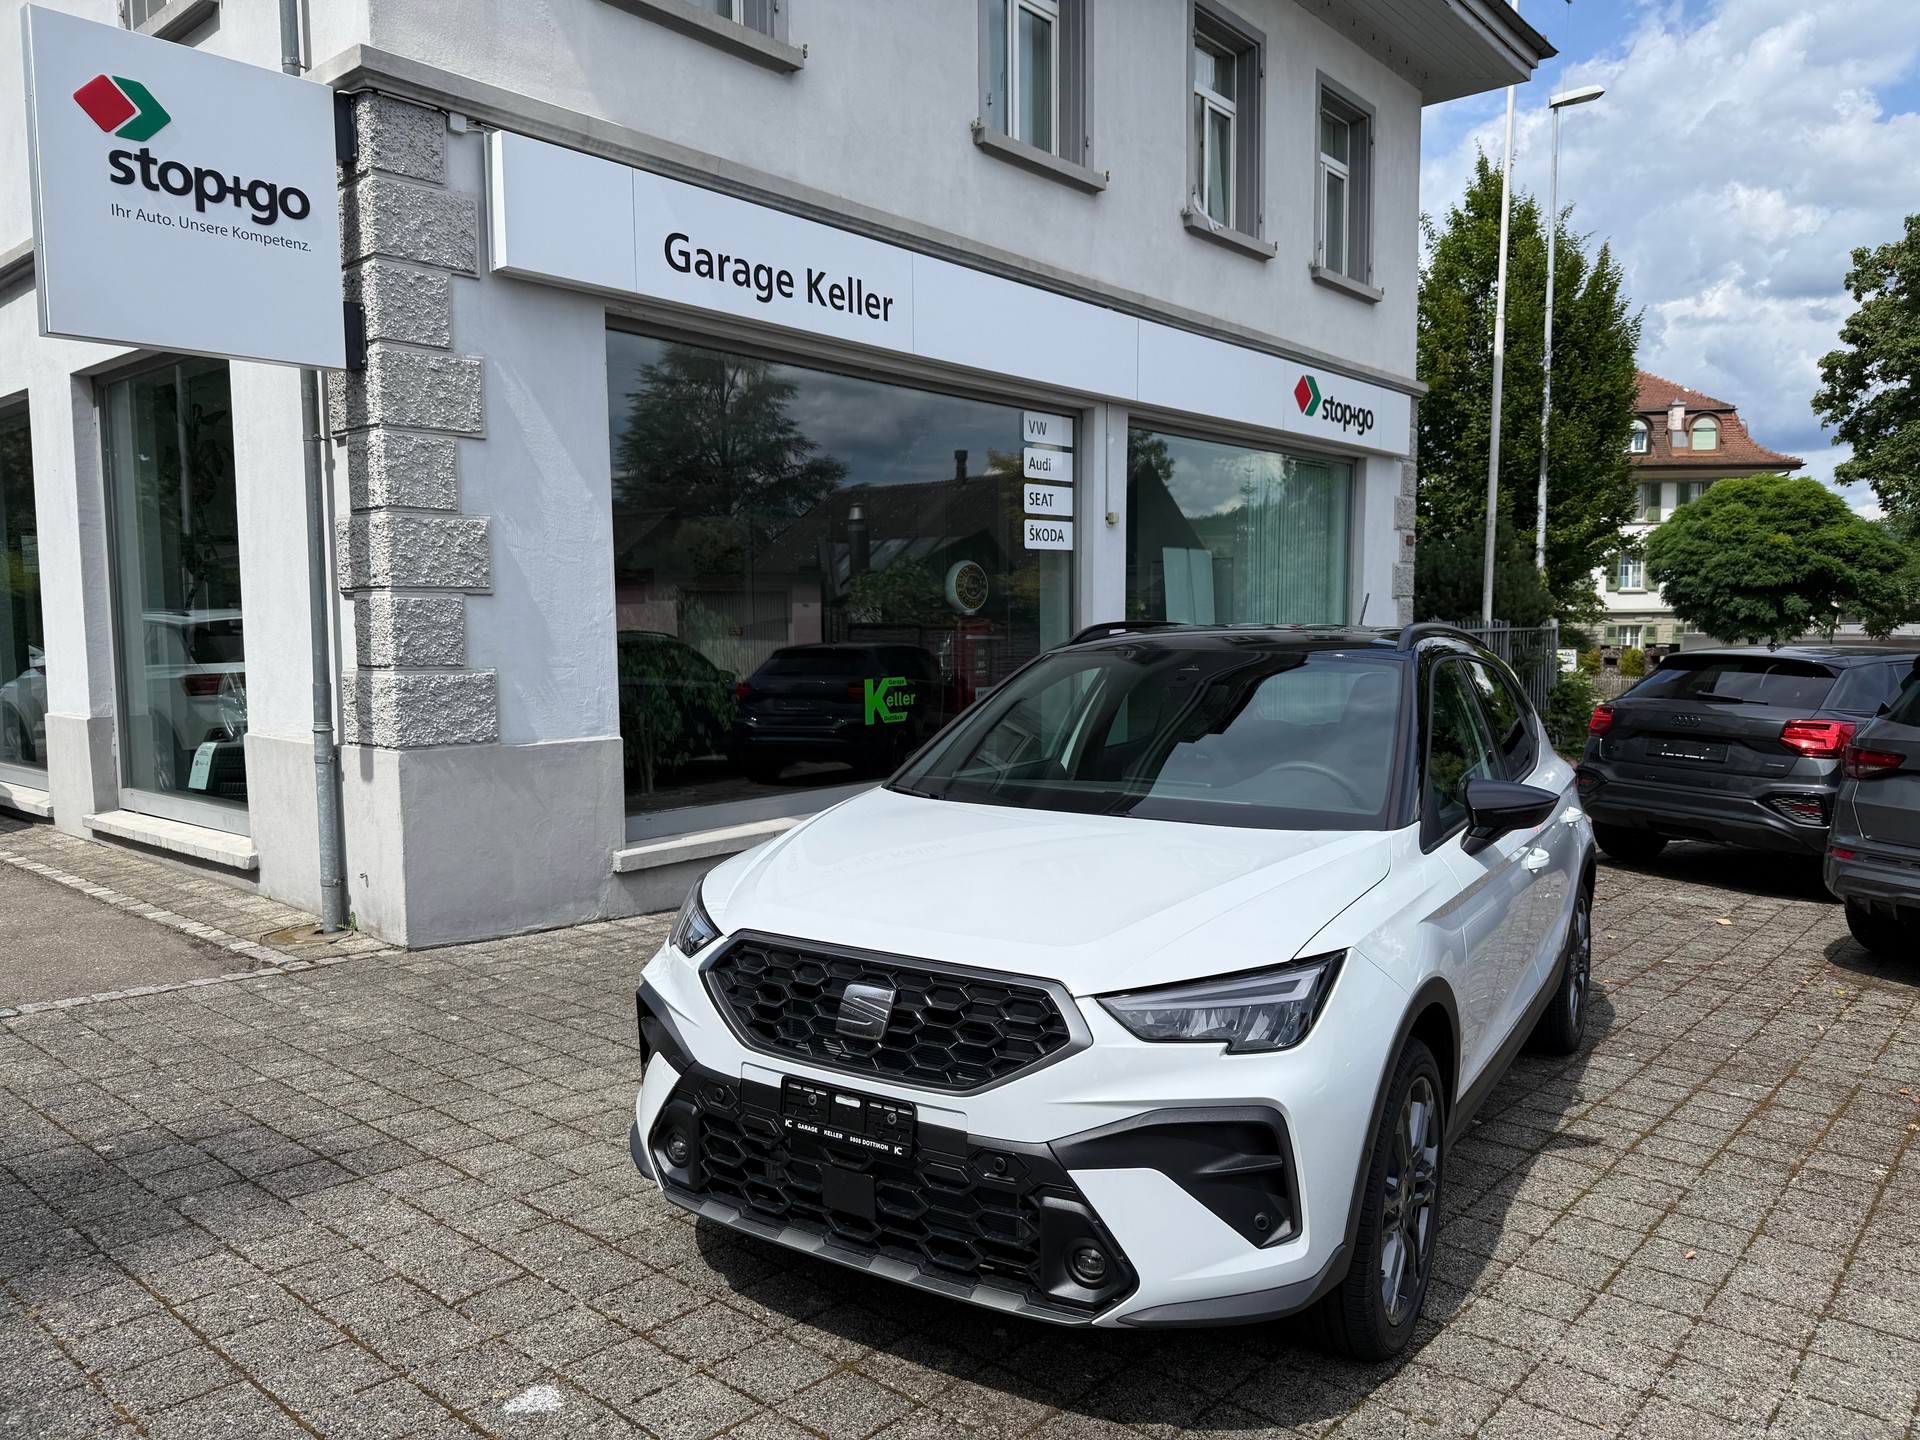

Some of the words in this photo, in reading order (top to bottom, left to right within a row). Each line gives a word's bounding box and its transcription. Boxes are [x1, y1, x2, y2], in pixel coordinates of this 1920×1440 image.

[108, 147, 311, 226] stop+go
[111, 203, 131, 219] Ihr
[136, 208, 175, 227] Auto.
[179, 215, 228, 237] Unsere
[232, 225, 312, 252] Kompetenz.
[664, 232, 794, 303] Garage
[806, 267, 894, 322] Keller
[1028, 419, 1047, 436] VW
[1322, 395, 1374, 436] stop+go
[1028, 456, 1052, 472] Audi
[1028, 491, 1054, 508] SEAT
[1029, 524, 1065, 543] ŠKODA
[864, 677, 916, 725] Keller
[797, 1123, 818, 1133] GARAGE
[823, 1130, 843, 1140] KELLER
[862, 1138, 889, 1151] DOTTIKON
